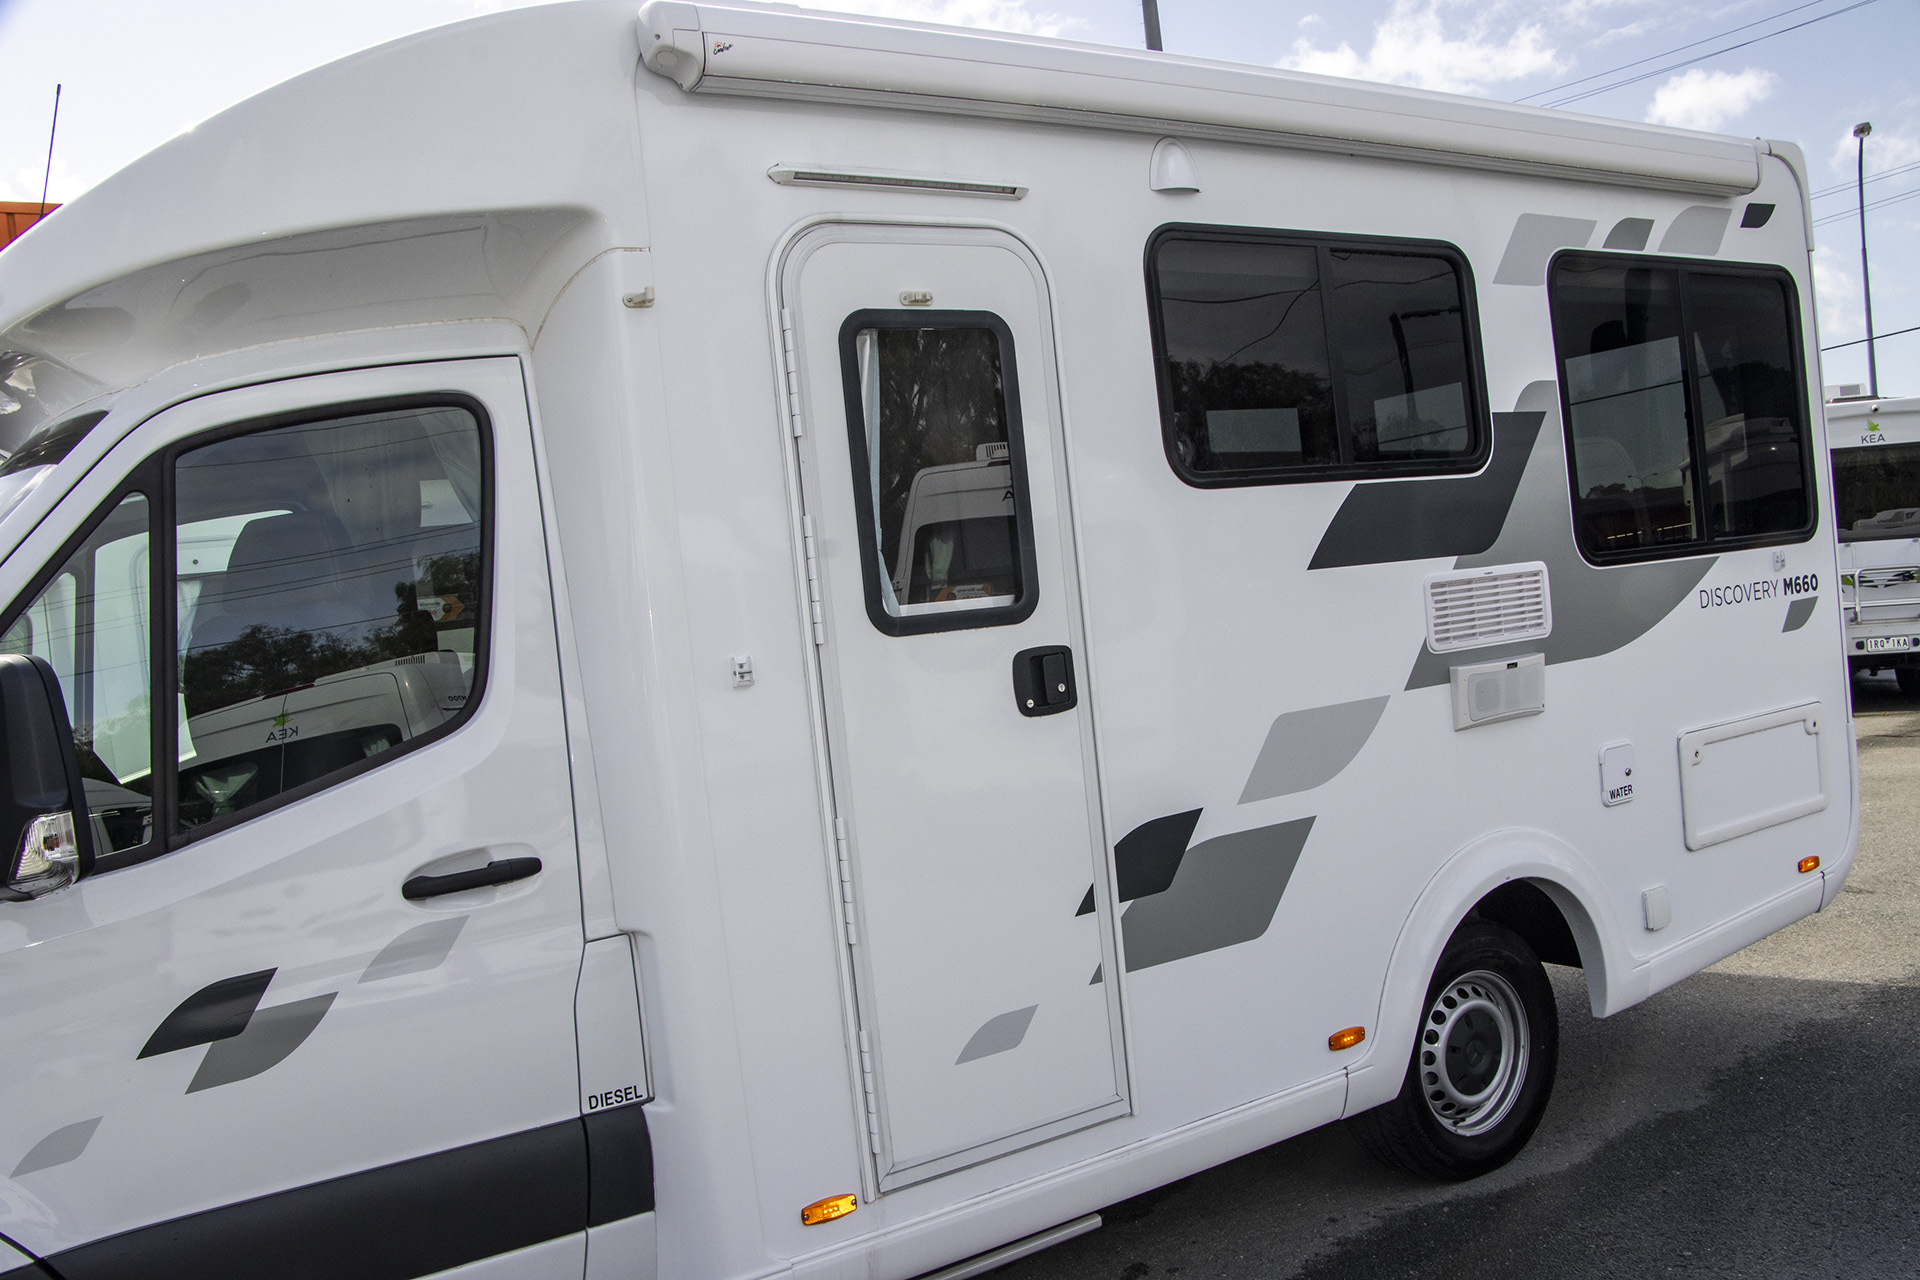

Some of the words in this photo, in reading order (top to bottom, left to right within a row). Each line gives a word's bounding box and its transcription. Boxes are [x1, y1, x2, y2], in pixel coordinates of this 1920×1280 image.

[1860, 433, 1886, 444] KEA
[1699, 579, 1779, 609] DISCOVERY
[1783, 573, 1819, 596] M660
[1608, 784, 1634, 800] WATER
[588, 1085, 643, 1110] DIESEL
